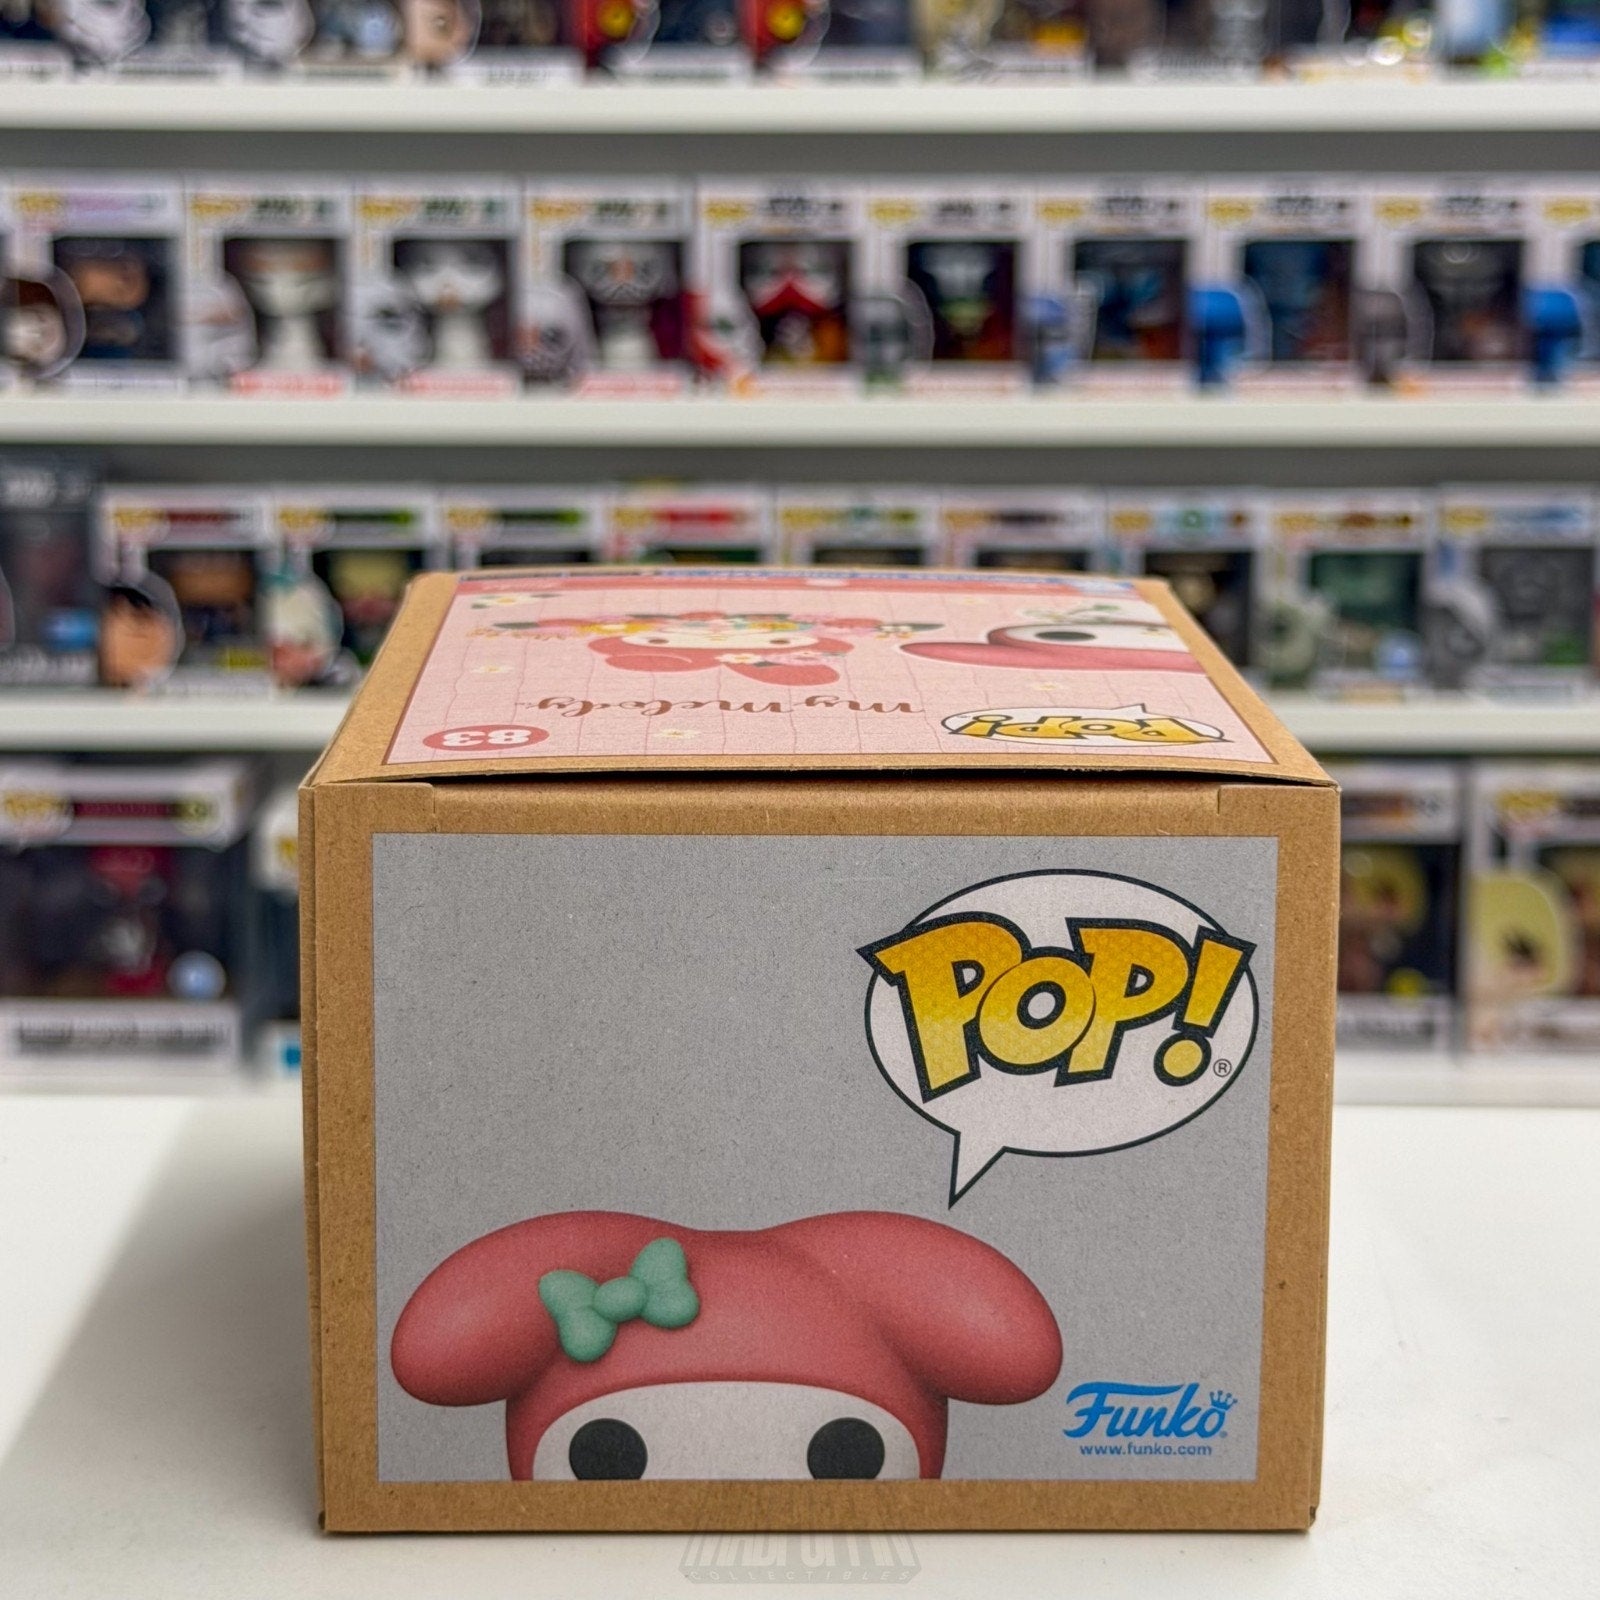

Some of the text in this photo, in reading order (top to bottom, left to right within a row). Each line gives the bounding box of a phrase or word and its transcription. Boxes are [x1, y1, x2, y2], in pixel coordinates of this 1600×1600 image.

[442, 728, 532, 748] 83
[948, 714, 1234, 743] POP!
[855, 911, 1258, 1104] POP!
[1063, 1381, 1227, 1439] Funko
[1079, 1442, 1213, 1456] www.funko.com
